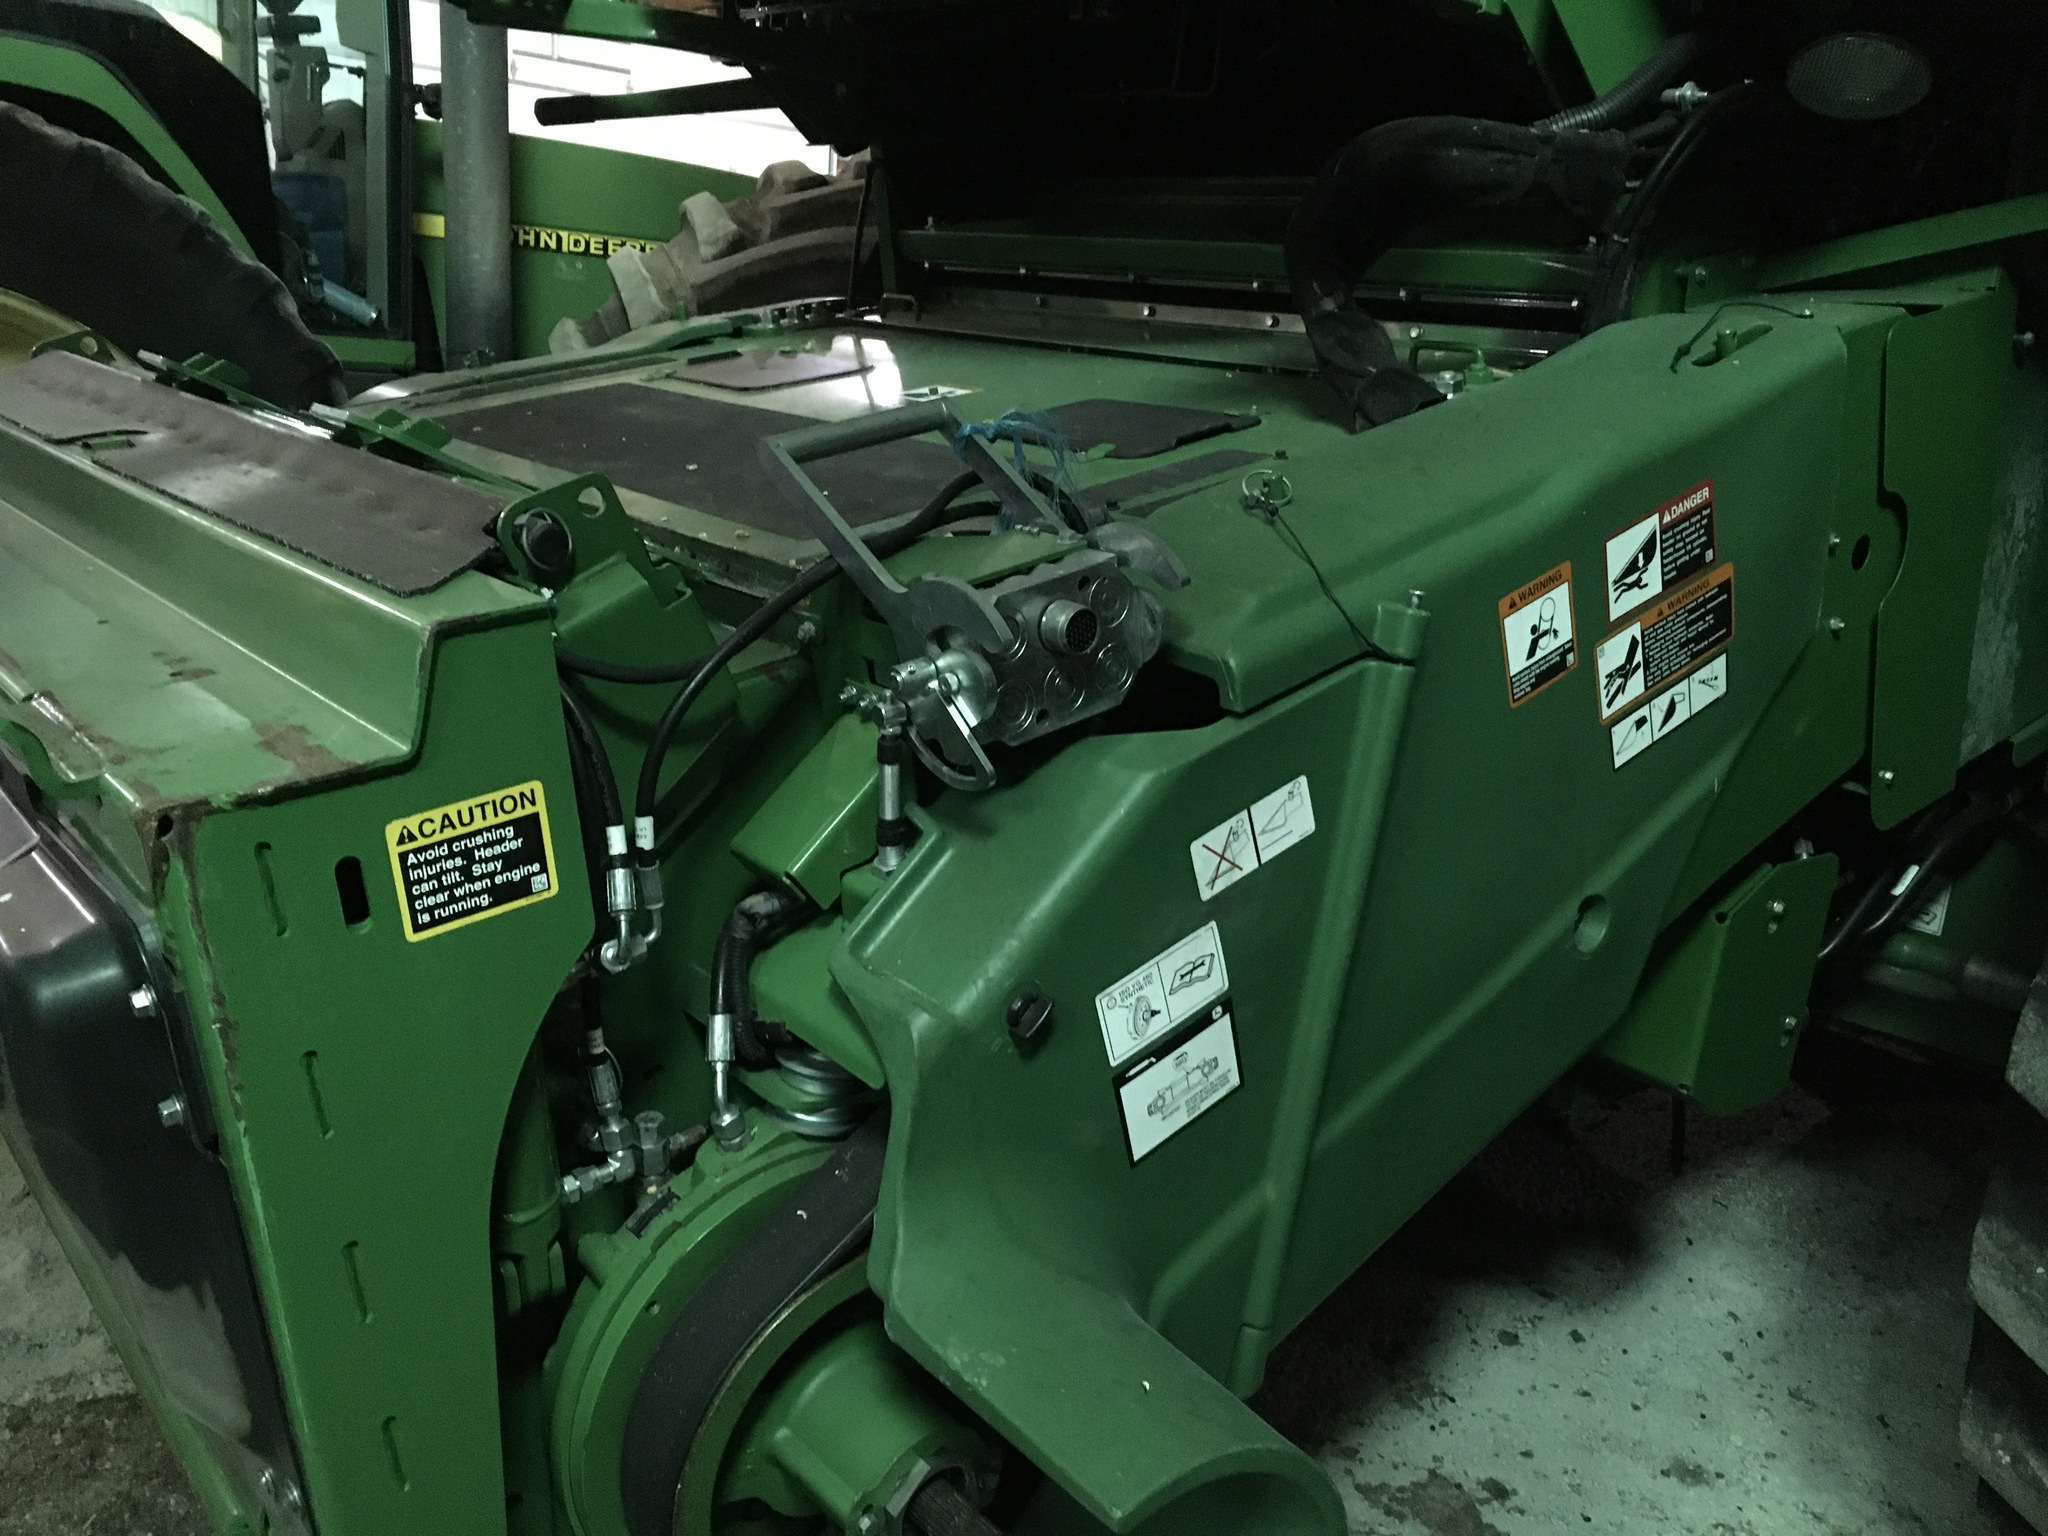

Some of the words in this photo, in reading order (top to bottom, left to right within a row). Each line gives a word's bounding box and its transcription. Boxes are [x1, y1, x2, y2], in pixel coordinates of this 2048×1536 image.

[517, 227, 558, 250] HN
[1671, 487, 1710, 520] DANGER
[1517, 569, 1562, 604] WARNING
[1667, 579, 1711, 610] WARNING
[417, 788, 537, 839] CAUTION
[406, 843, 449, 867] Avoid
[452, 825, 514, 853] crushing
[474, 836, 523, 861] Header
[411, 879, 438, 896] can
[441, 871, 465, 887] tilt.
[471, 859, 503, 877] Stay
[414, 891, 450, 910] clear
[453, 878, 491, 897] when
[494, 862, 541, 885] engine
[416, 911, 431, 925] is
[434, 895, 493, 920] running.
